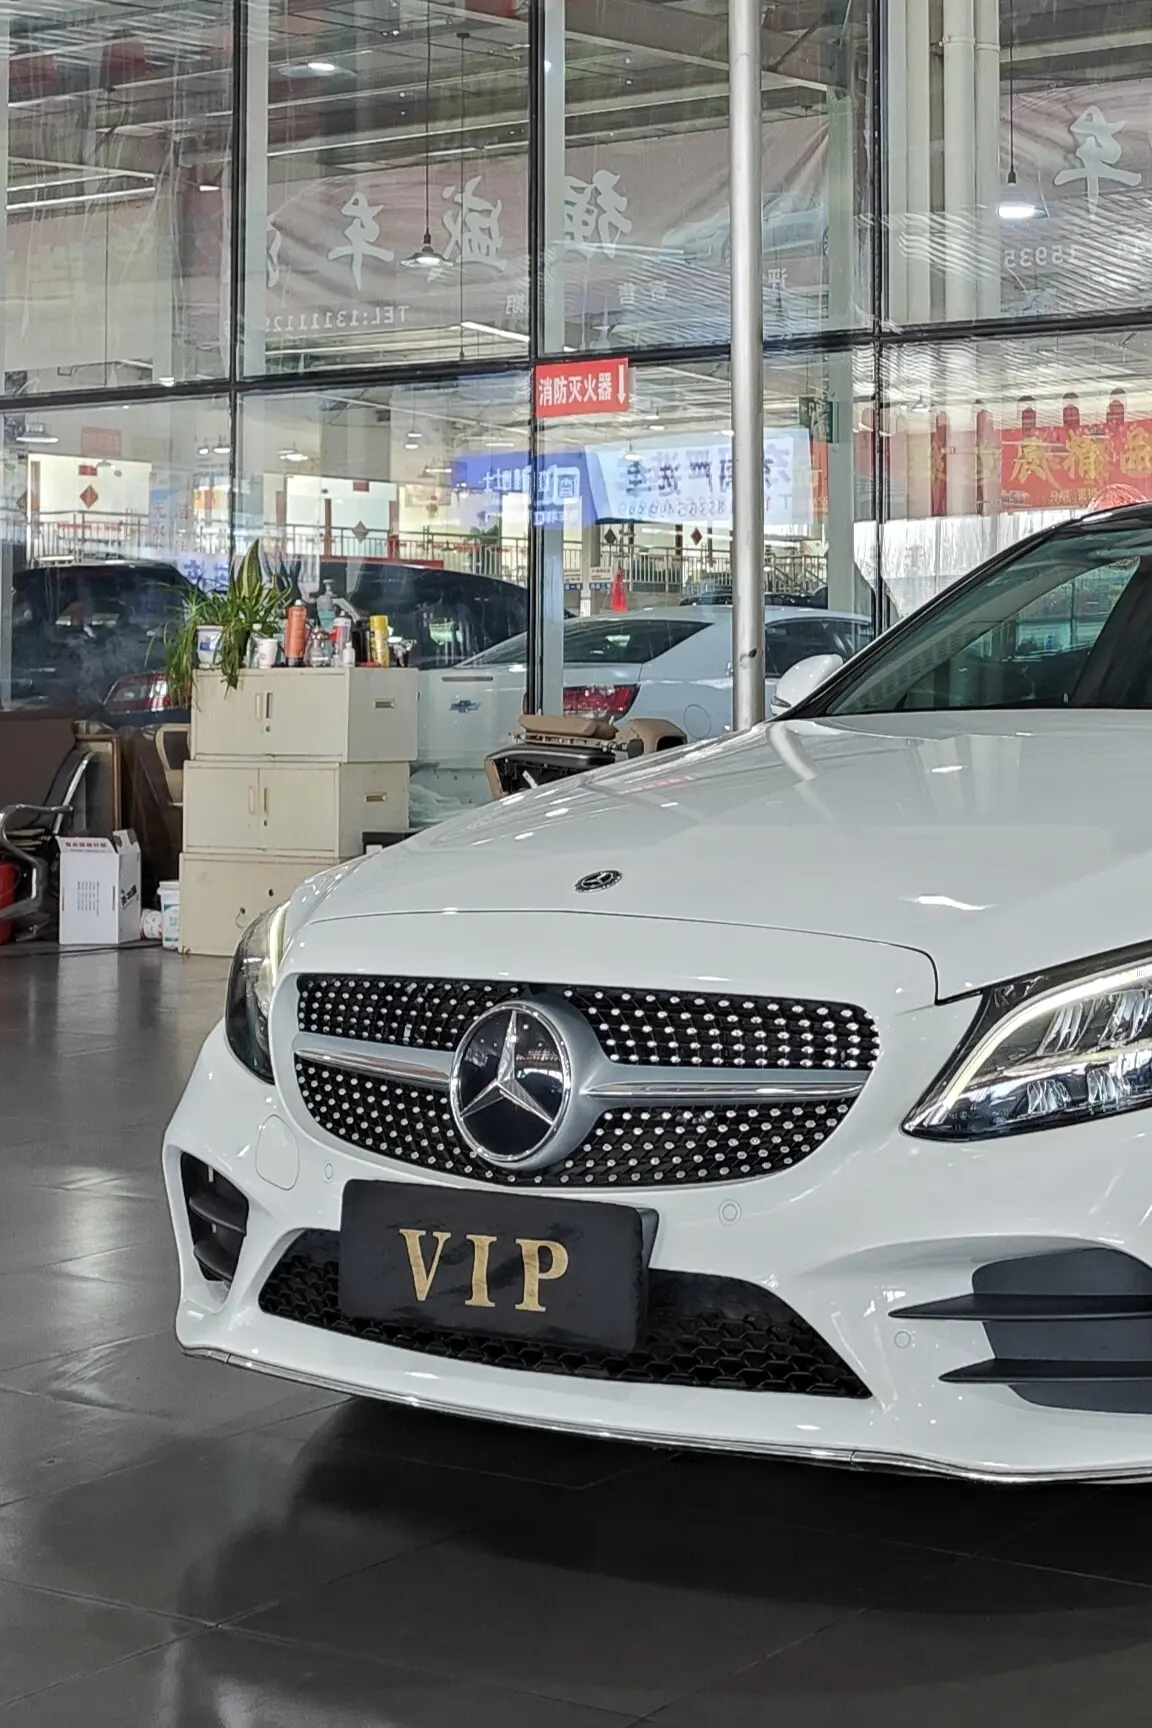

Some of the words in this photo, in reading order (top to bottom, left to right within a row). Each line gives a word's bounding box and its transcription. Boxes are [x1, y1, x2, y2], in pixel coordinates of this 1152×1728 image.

[538, 371, 613, 407] 消防灭火器
[399, 1228, 569, 1312] VIP
